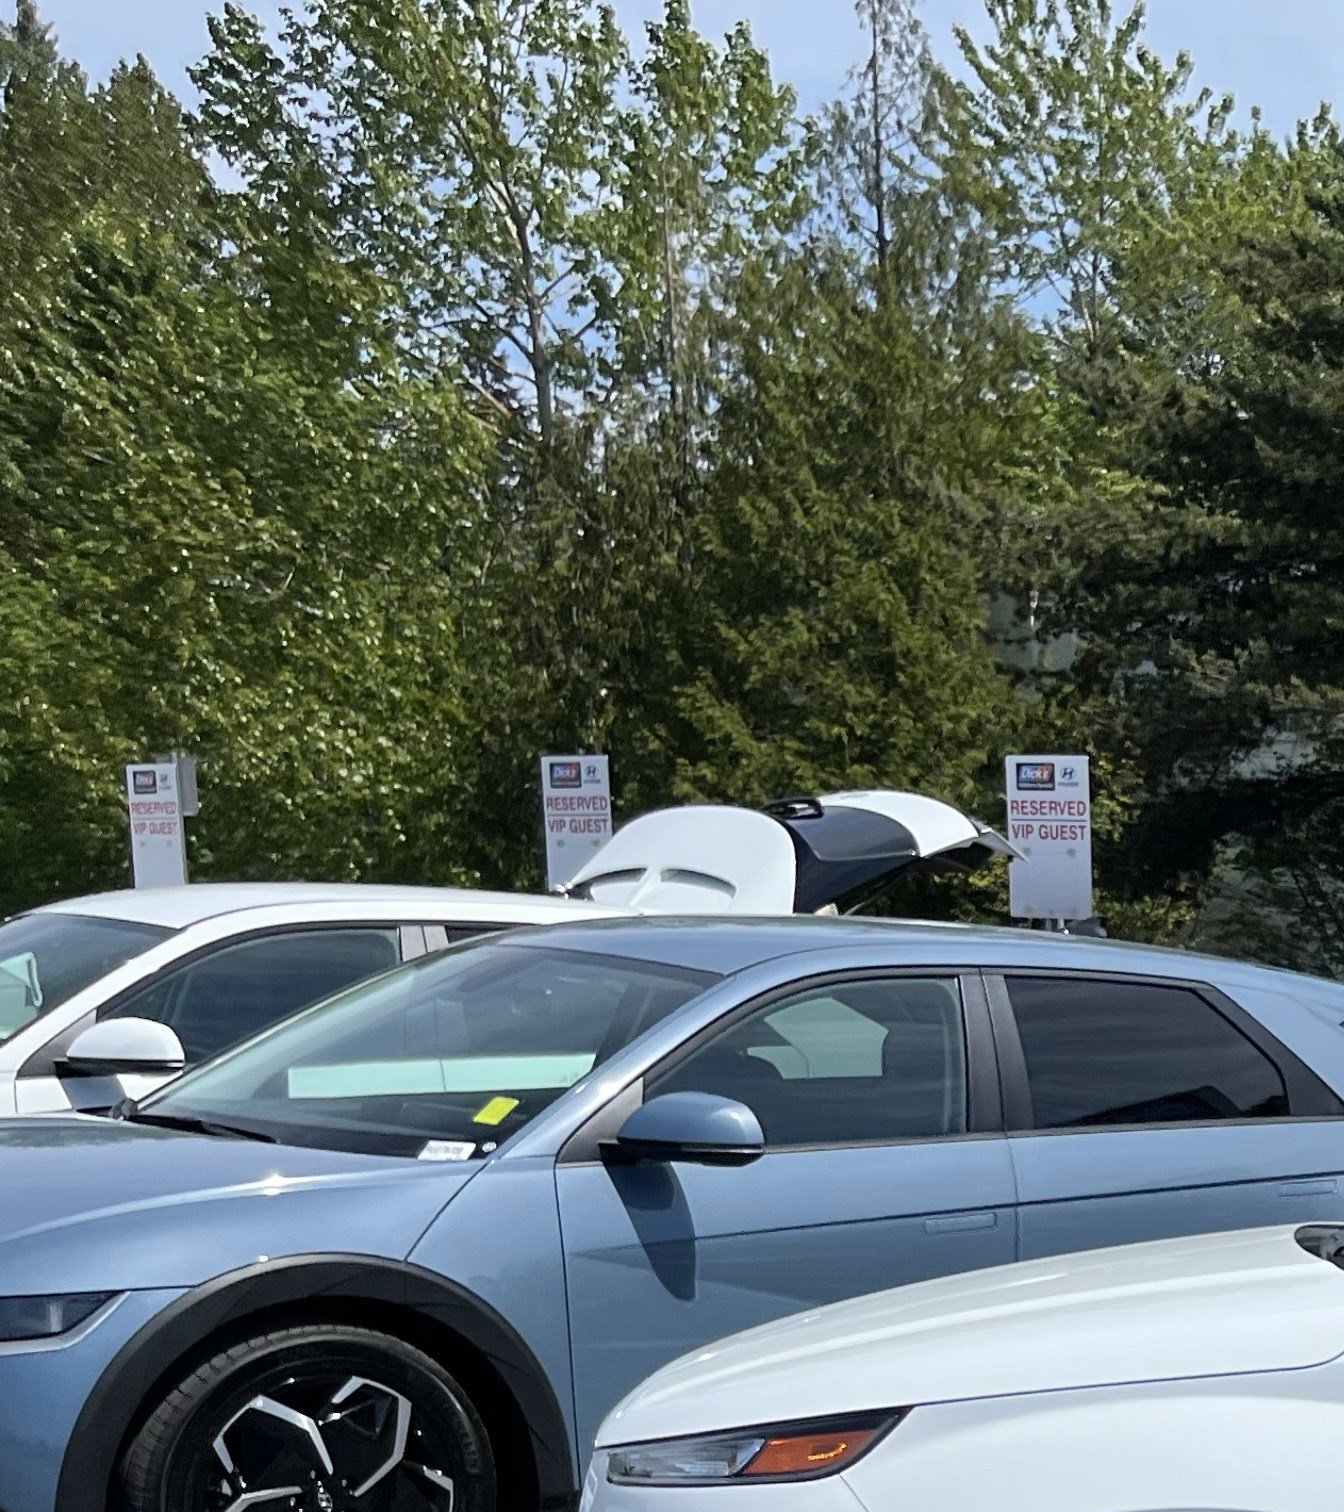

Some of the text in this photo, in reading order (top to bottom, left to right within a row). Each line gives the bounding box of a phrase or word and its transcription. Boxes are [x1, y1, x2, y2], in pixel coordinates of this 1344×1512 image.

[546, 796, 608, 812] RESERVED
[1010, 800, 1087, 816] RESERVED
[548, 819, 608, 833] VIP GUEST
[1012, 824, 1087, 840] VIP GUEST
